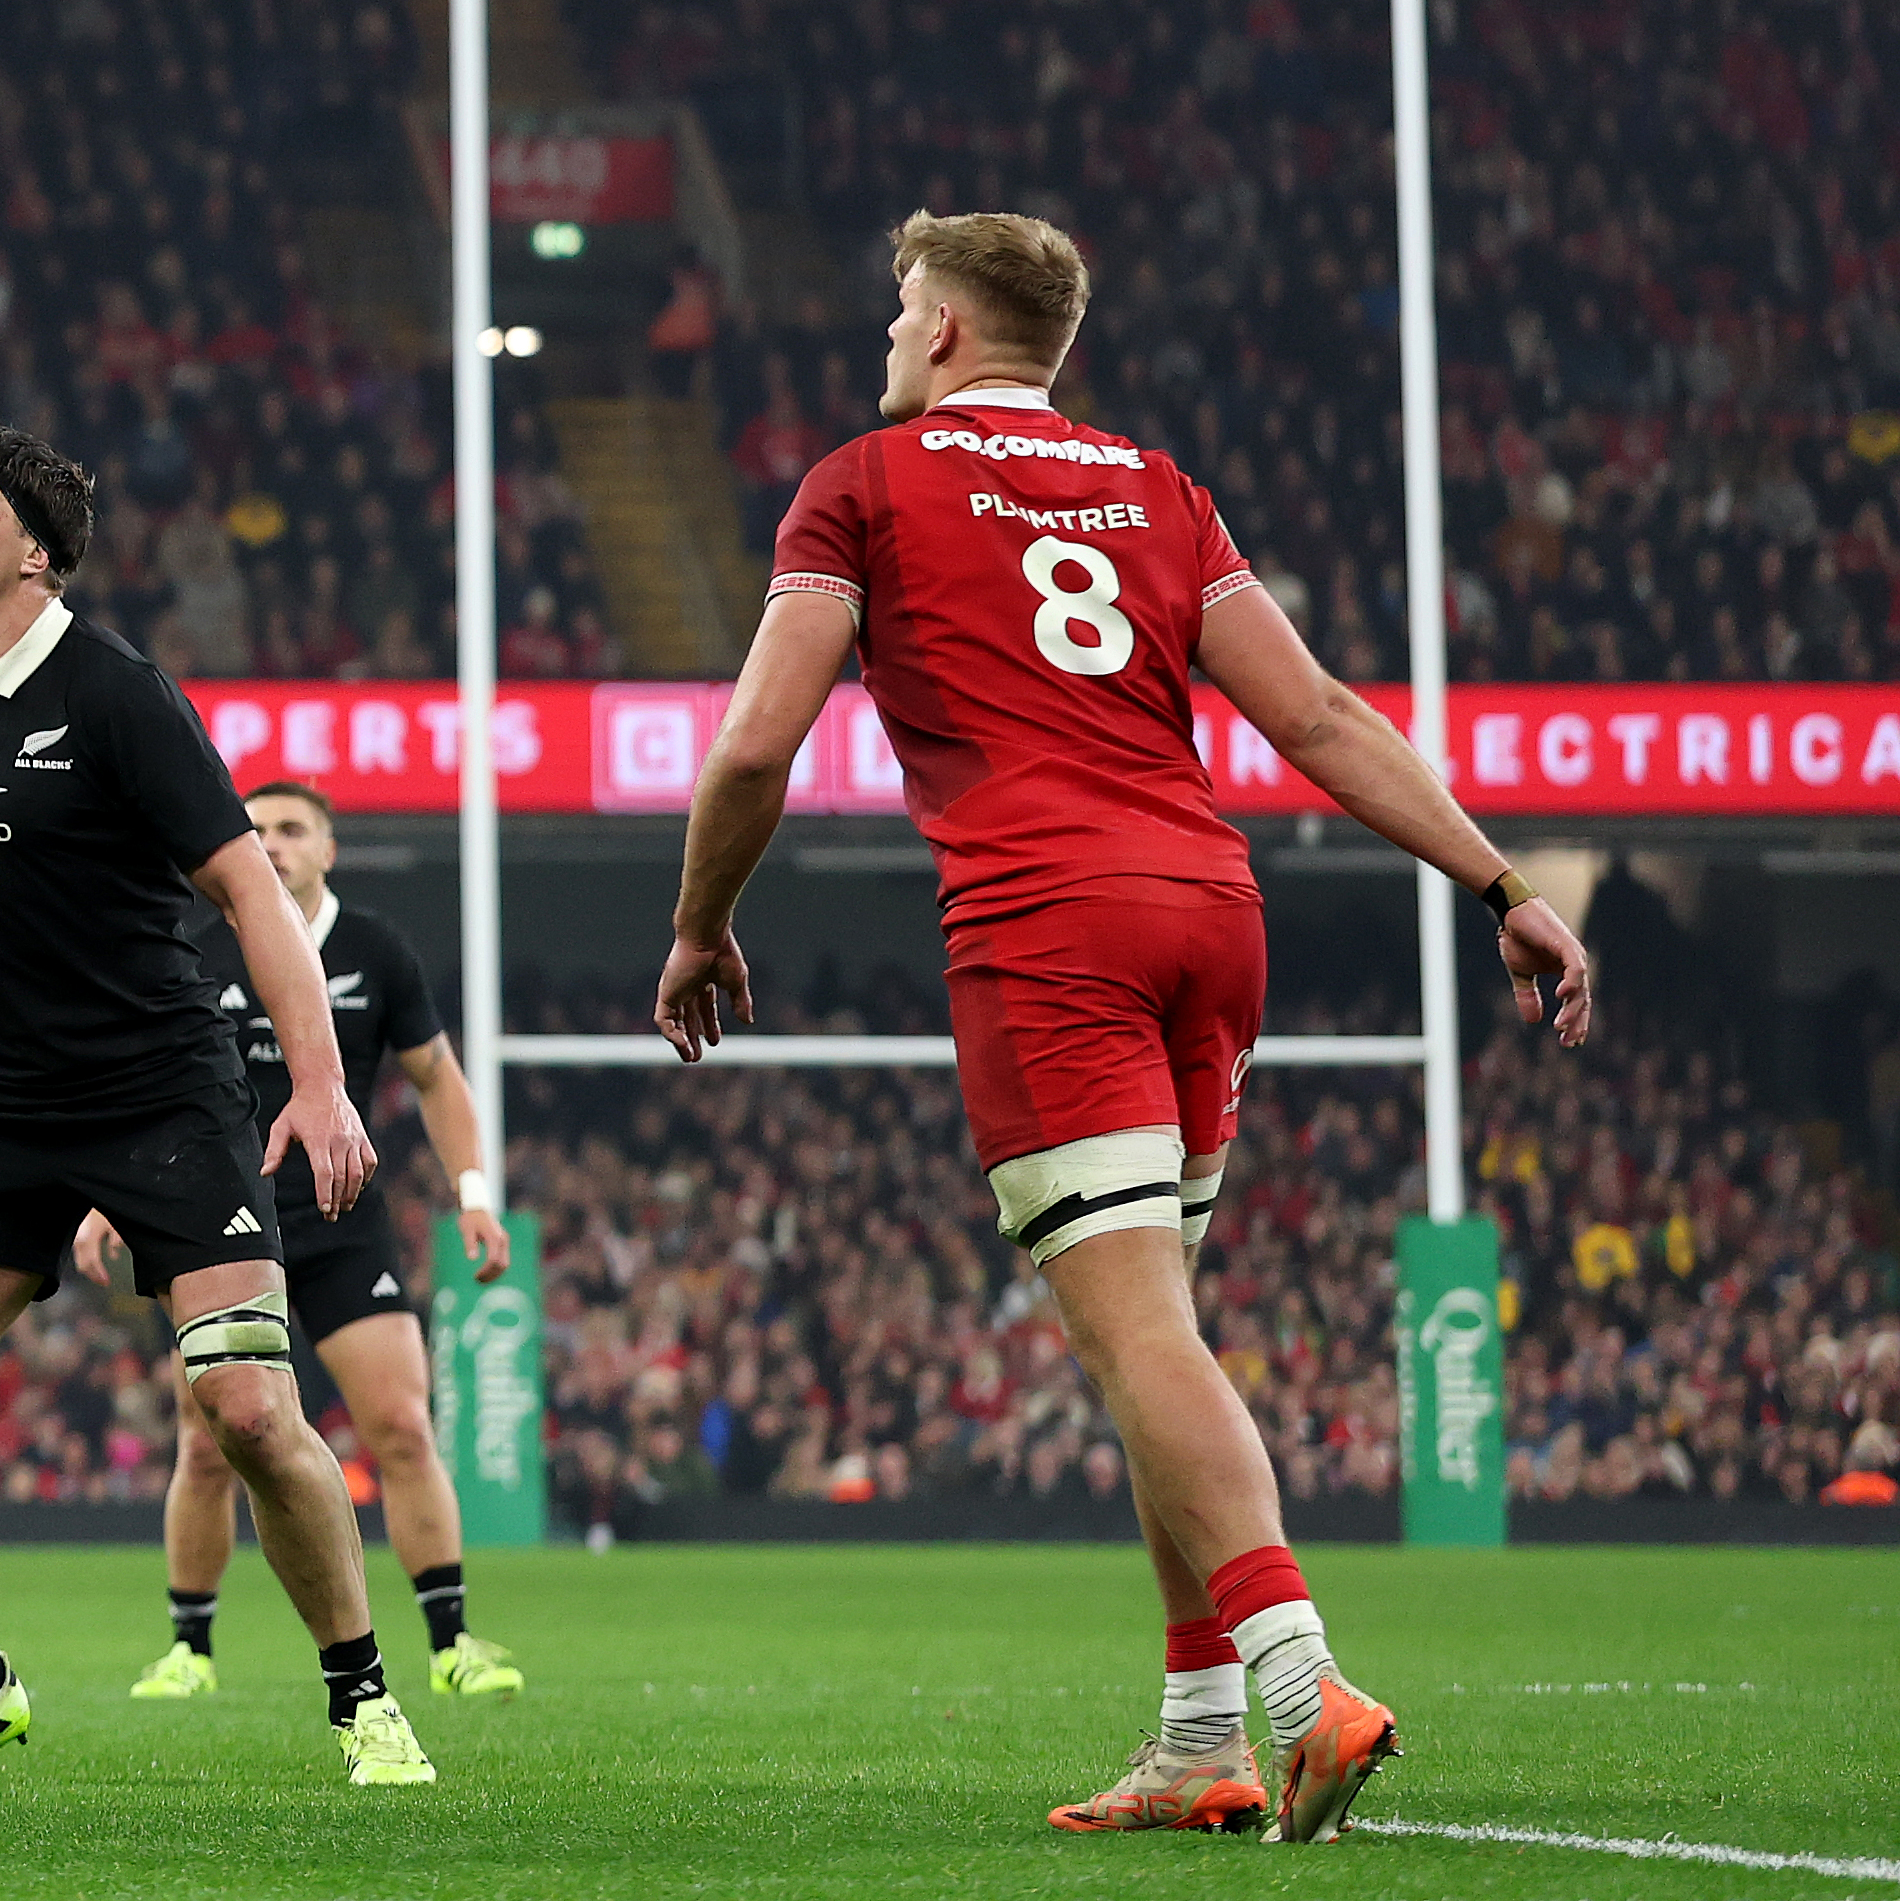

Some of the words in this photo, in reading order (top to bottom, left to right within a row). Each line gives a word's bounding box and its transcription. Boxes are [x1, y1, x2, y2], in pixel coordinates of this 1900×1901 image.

[921, 429, 1146, 470] GO.COMPARE
[1022, 534, 1135, 676] 8
[14, 758, 32, 768] ALL
[32, 759, 71, 771] BLACKS
